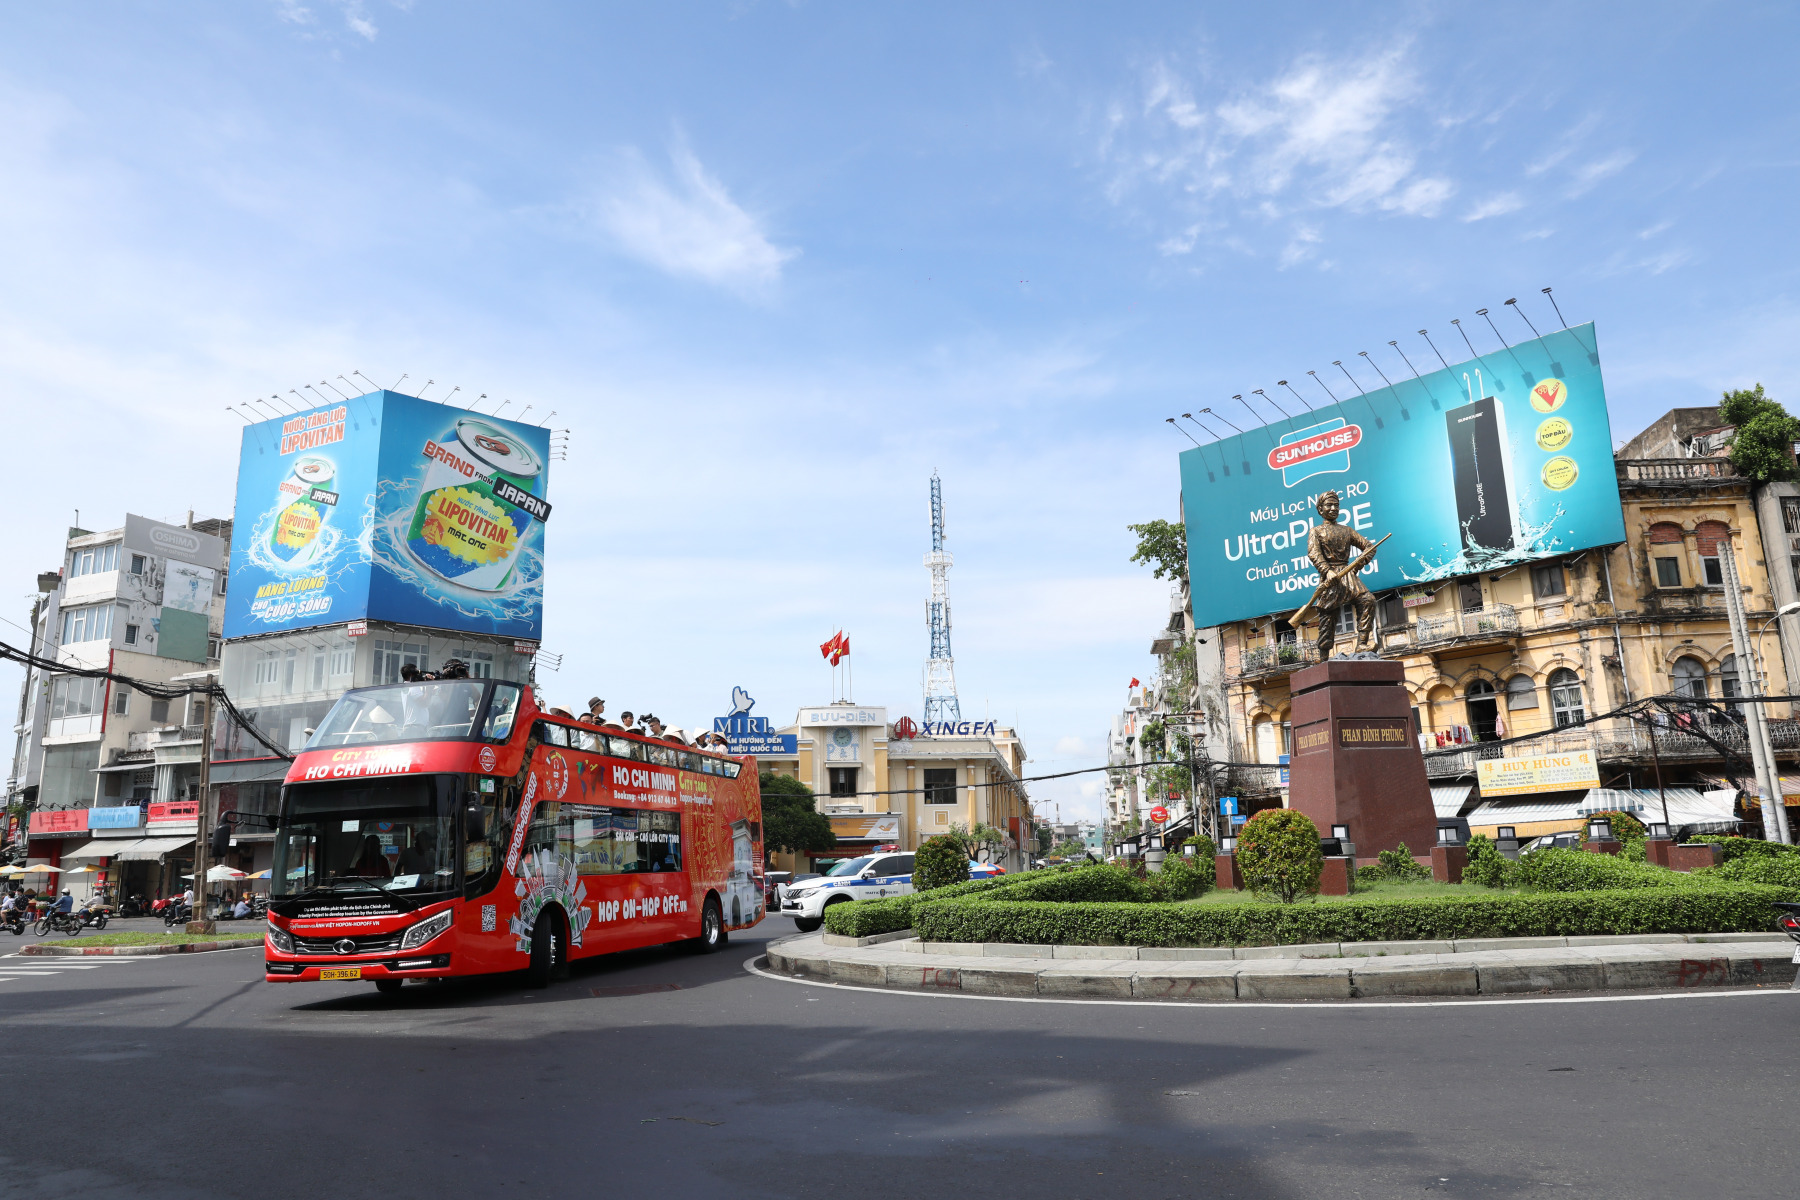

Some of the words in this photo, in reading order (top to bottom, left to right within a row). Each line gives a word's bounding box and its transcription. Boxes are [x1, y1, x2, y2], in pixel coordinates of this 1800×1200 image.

[280, 422, 345, 456] LIPOVITAN
[1276, 431, 1353, 463] SUNHOUSE
[423, 440, 475, 478] BRAND
[475, 472, 494, 485] FROM
[497, 483, 547, 518] JAPAN
[311, 490, 337, 504] JAPAN
[1250, 507, 1278, 524] Máy
[1281, 501, 1305, 516] Lọc
[1346, 481, 1369, 498] RO
[1475, 482, 1486, 517] UltraPURE
[284, 513, 317, 531] LIPOVITAN
[438, 497, 509, 544] LIPOVITAN
[156, 531, 194, 549] OSHIMA
[1246, 560, 1289, 582] Chuẩn
[1291, 555, 1315, 571] TIN
[1274, 573, 1320, 594] UỐNG
[252, 600, 269, 611] CHO
[811, 710, 876, 723] BƯU-ĐIỆN
[716, 718, 768, 734] MIRI
[921, 721, 995, 736] XINGFA
[1342, 729, 1361, 741] PHAN
[1362, 725, 1380, 741] ĐÌNH
[1381, 725, 1404, 741] PHÙNG
[731, 744, 748, 753] HIỆU
[750, 743, 770, 752] QUỐC
[739, 736, 765, 745] HƯỚNG
[767, 734, 782, 744] ĐẾN
[332, 751, 362, 762] CITY
[827, 743, 836, 761] P
[840, 748, 848, 758] &
[851, 743, 859, 760] T
[305, 765, 330, 779] HO
[333, 761, 362, 777] CHI
[365, 759, 412, 775] MINH
[1502, 763, 1529, 771] HUY
[1533, 757, 1571, 769] HÙNG
[613, 765, 629, 786] HO
[631, 769, 649, 788] CHI
[651, 771, 676, 791] MINH
[598, 900, 620, 923] HOP
[622, 896, 660, 920] ON-HOP
[323, 970, 358, 979] 50H-396.62
